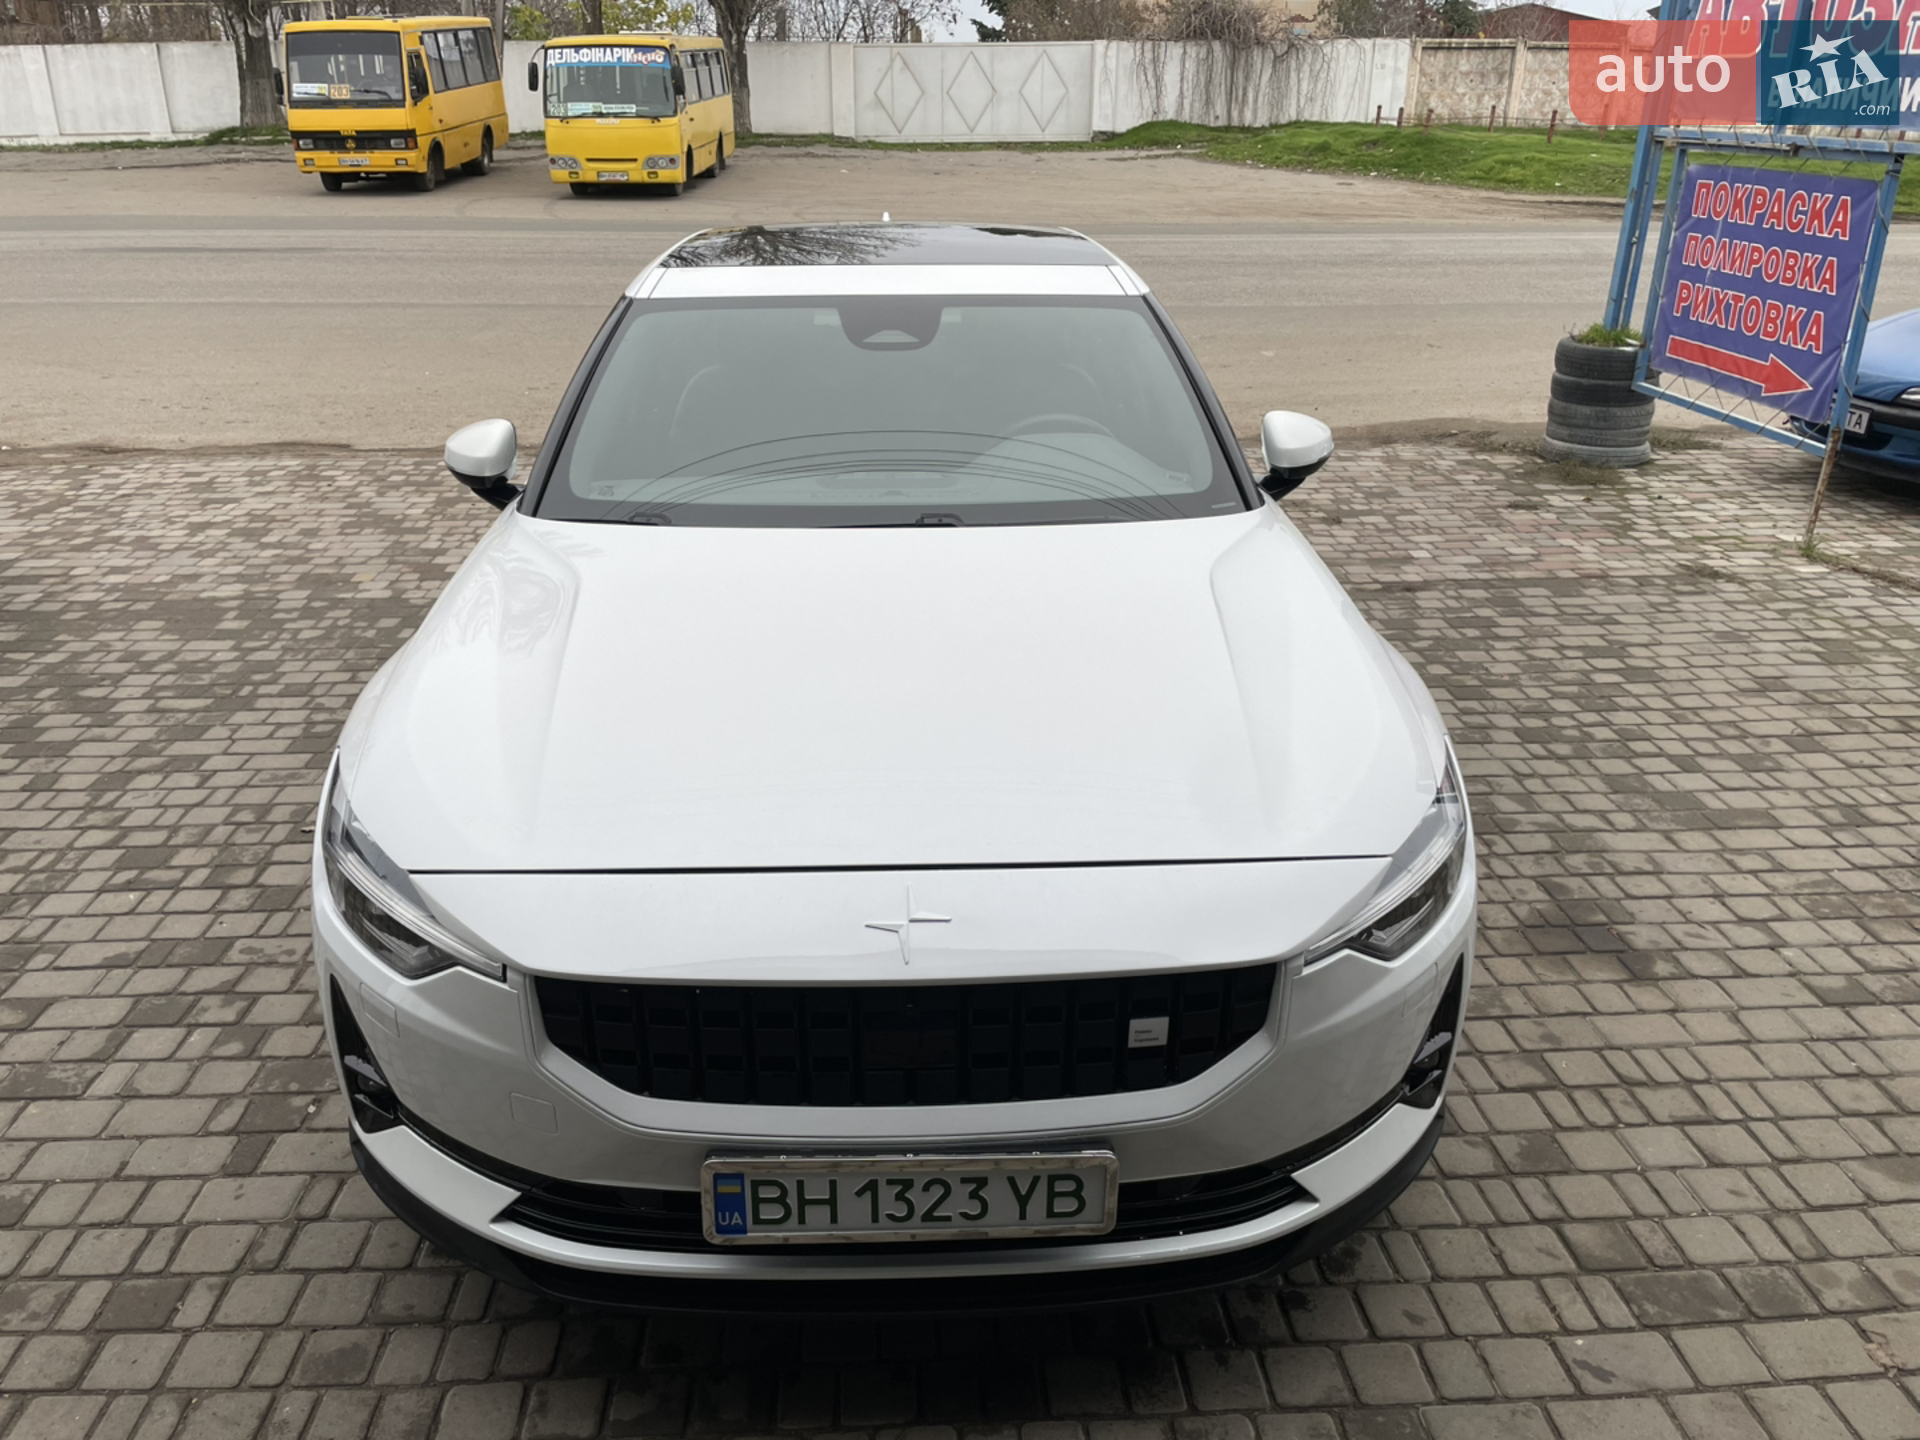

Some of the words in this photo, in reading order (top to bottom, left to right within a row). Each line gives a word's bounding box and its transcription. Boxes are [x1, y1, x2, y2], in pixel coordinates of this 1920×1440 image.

[331, 86, 349, 98] 203
[1692, 180, 1851, 240] ПОКРАСКА
[1682, 232, 1837, 295] ПОЛИРОВКА
[1673, 279, 1824, 355] РИХТОВКА
[718, 1211, 743, 1227] UA
[750, 1178, 839, 1226] BH
[853, 1176, 989, 1224] 1323
[1006, 1173, 1087, 1221] YB
